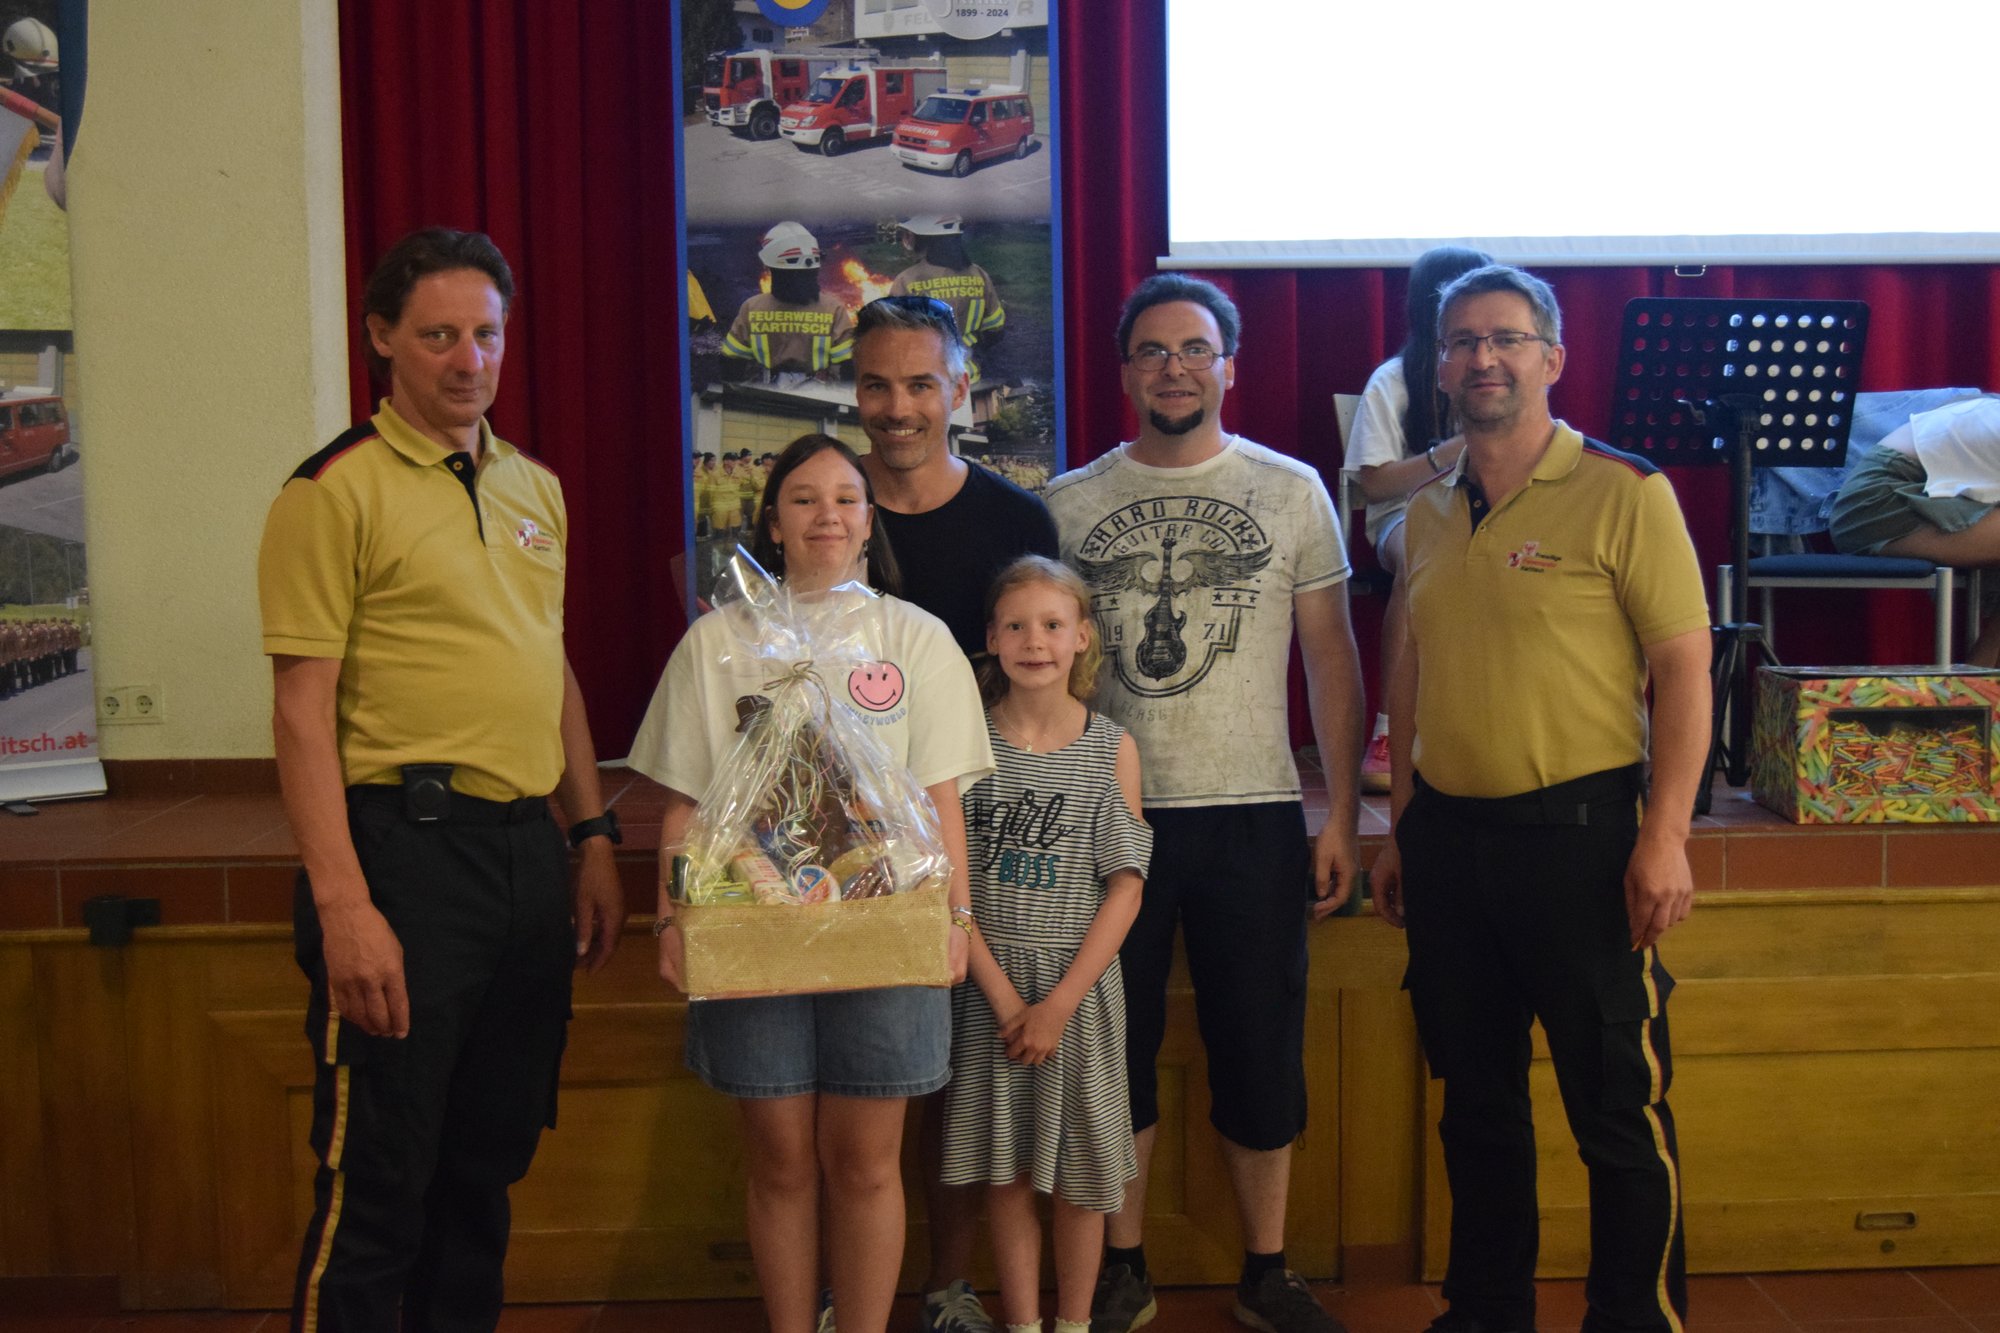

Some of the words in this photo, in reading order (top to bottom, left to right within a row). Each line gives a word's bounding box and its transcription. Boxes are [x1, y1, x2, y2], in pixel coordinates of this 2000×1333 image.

[955, 9, 977, 17] 1899
[986, 9, 1009, 17] 2024
[907, 275, 985, 293] FEUERWEHR
[748, 311, 834, 324] FEUERWEHR
[750, 322, 831, 334] KARTITSCH
[1094, 500, 1167, 545] HARD
[1184, 499, 1254, 537] ROCK
[1113, 523, 1193, 554] GUITAR
[1107, 623, 1123, 642] 19
[998, 848, 1062, 889] BOSS
